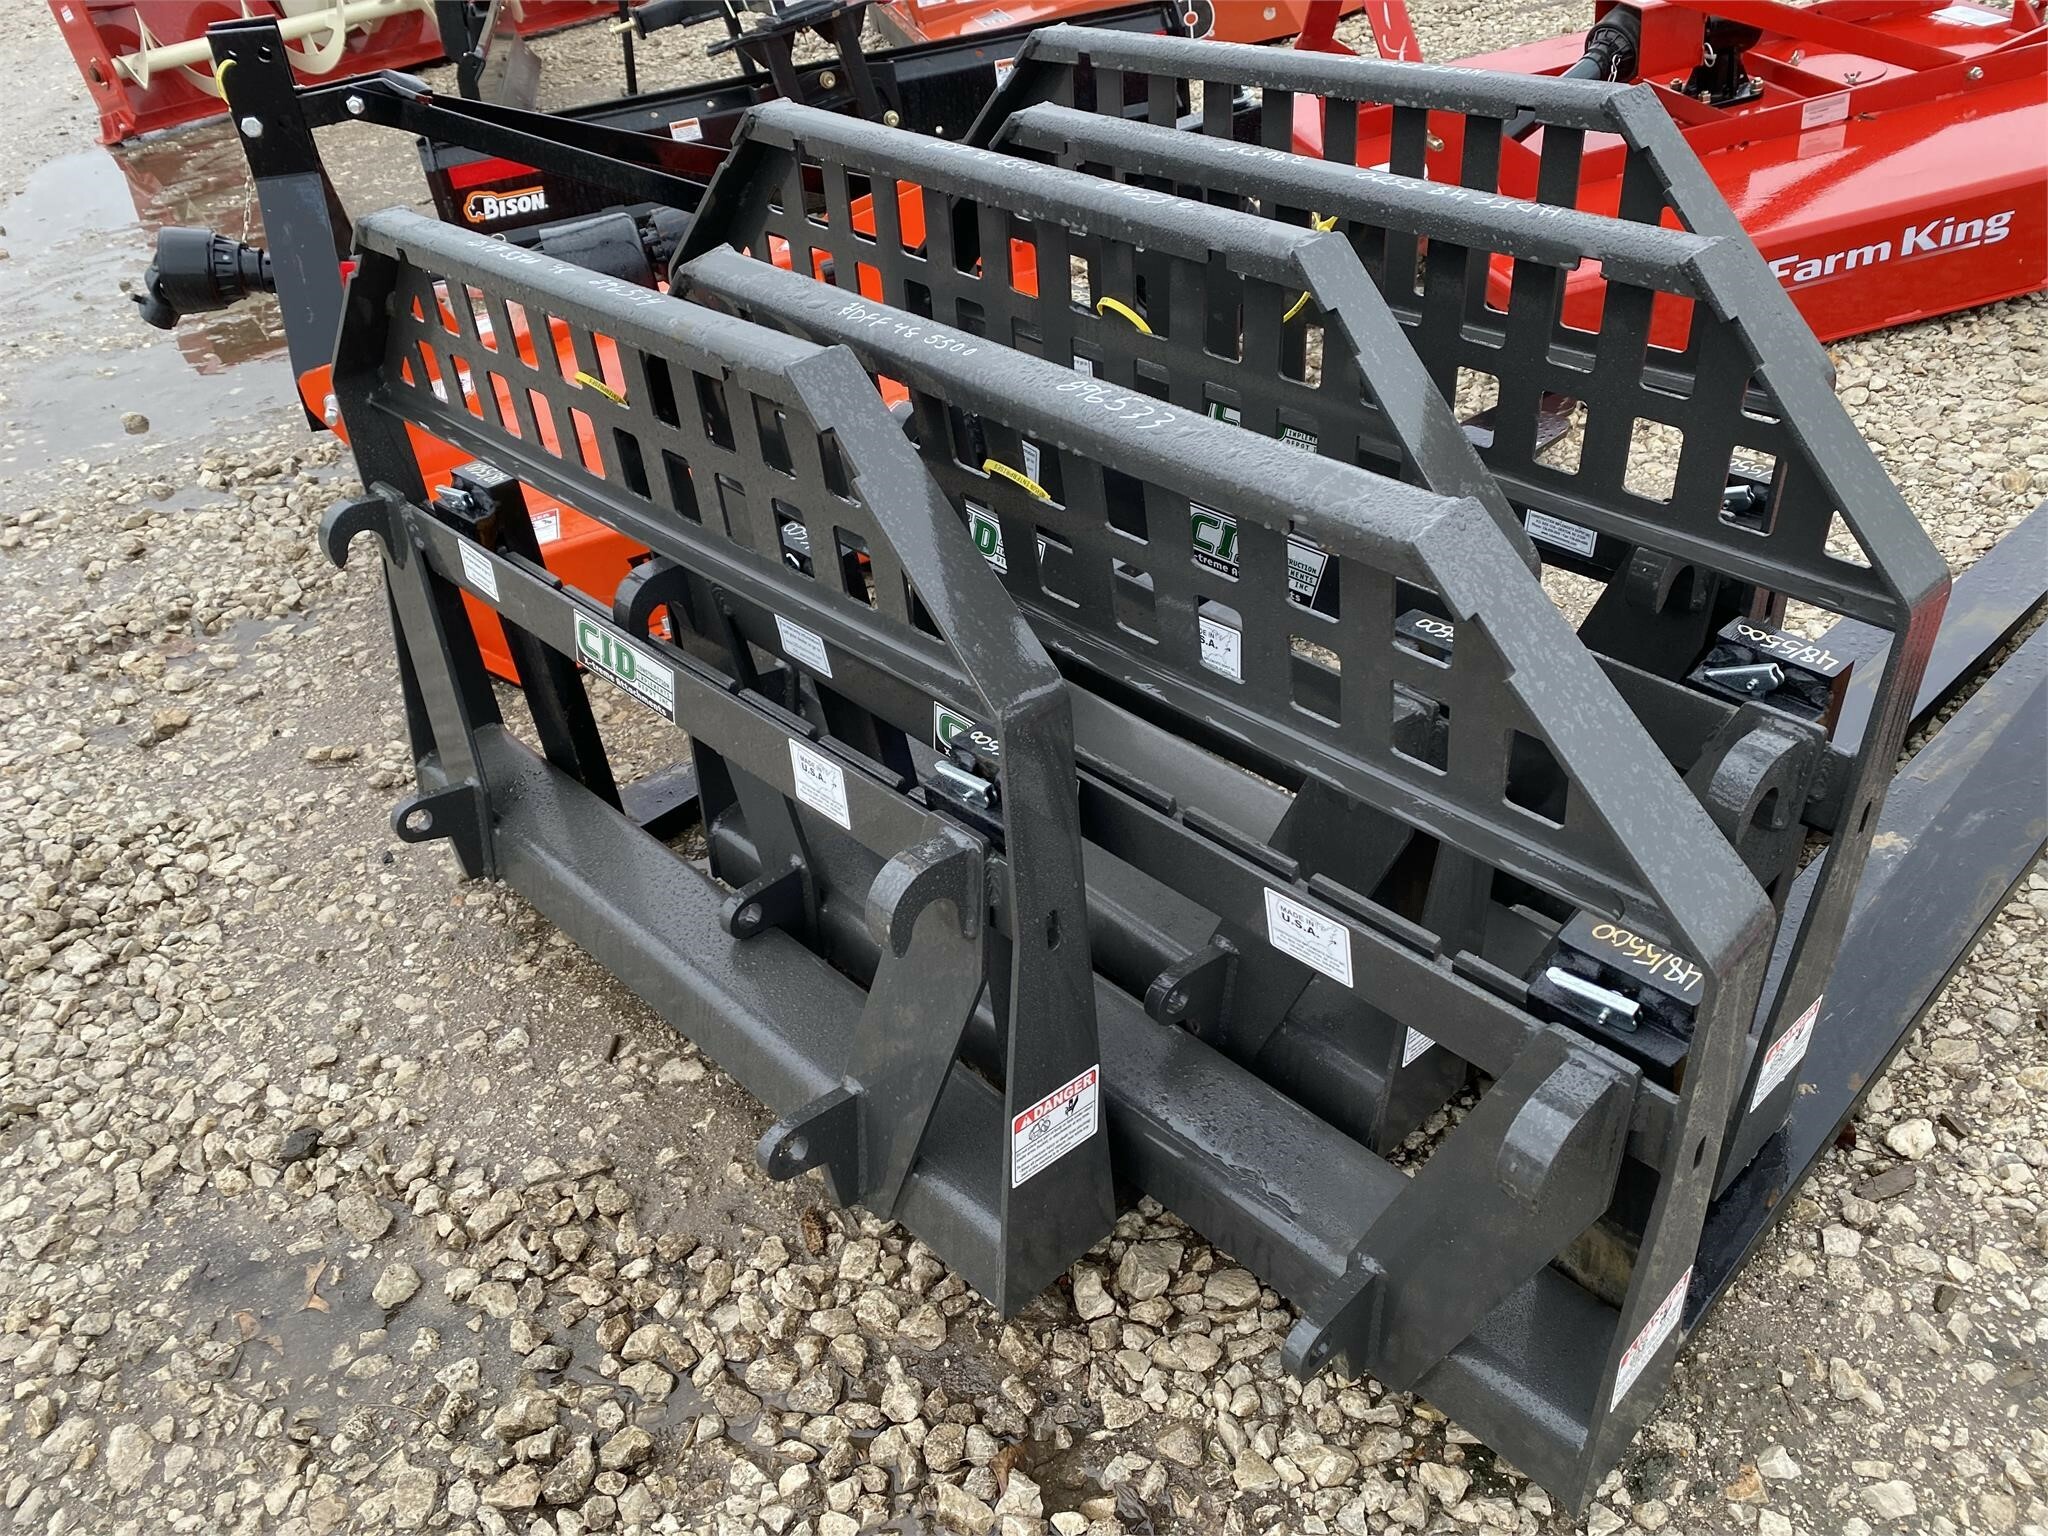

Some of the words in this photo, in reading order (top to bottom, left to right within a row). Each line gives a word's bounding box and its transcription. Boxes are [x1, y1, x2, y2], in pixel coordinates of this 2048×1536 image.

[483, 193, 545, 219] BISON
[1767, 240, 1893, 283] Farm
[1900, 210, 2016, 257] King
[838, 301, 894, 328] HDFF
[923, 333, 979, 357] 5500
[1055, 379, 1177, 430] 896533
[1190, 512, 1240, 564] CI
[1289, 558, 1317, 575] RUCTION
[577, 619, 638, 683] CID
[1737, 624, 1840, 672] 48/5500
[1279, 905, 1304, 921] MADE
[1281, 912, 1321, 940] U.S.A.
[1591, 923, 1704, 992] 48/5500
[1032, 1073, 1094, 1120] DANGER
